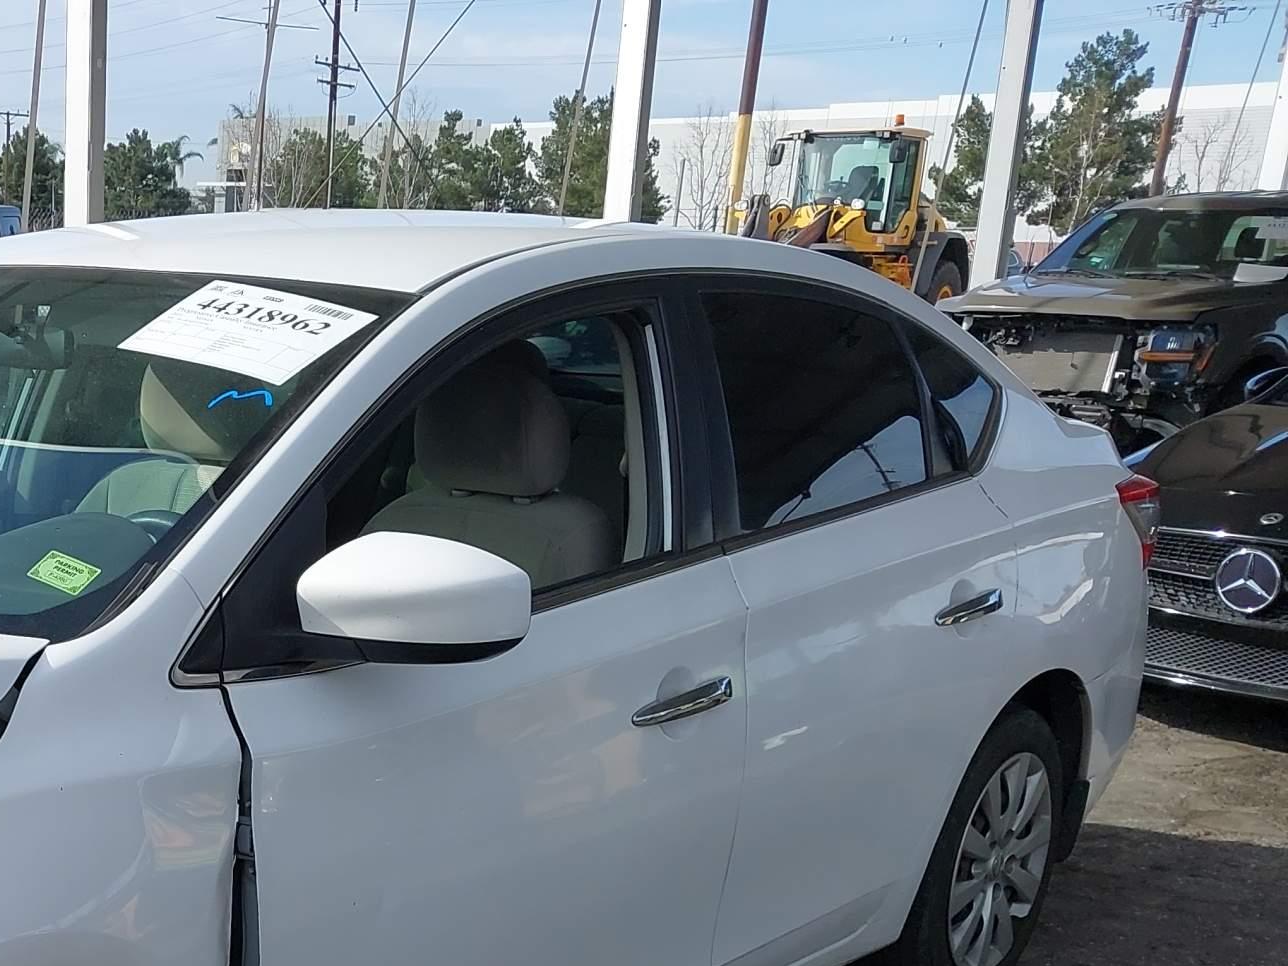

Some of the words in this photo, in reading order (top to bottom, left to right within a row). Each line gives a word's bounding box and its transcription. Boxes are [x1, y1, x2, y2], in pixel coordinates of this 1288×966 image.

[196, 298, 332, 336] 44318962
[52, 565, 78, 578] PERMIT
[54, 559, 85, 575] PARKING
